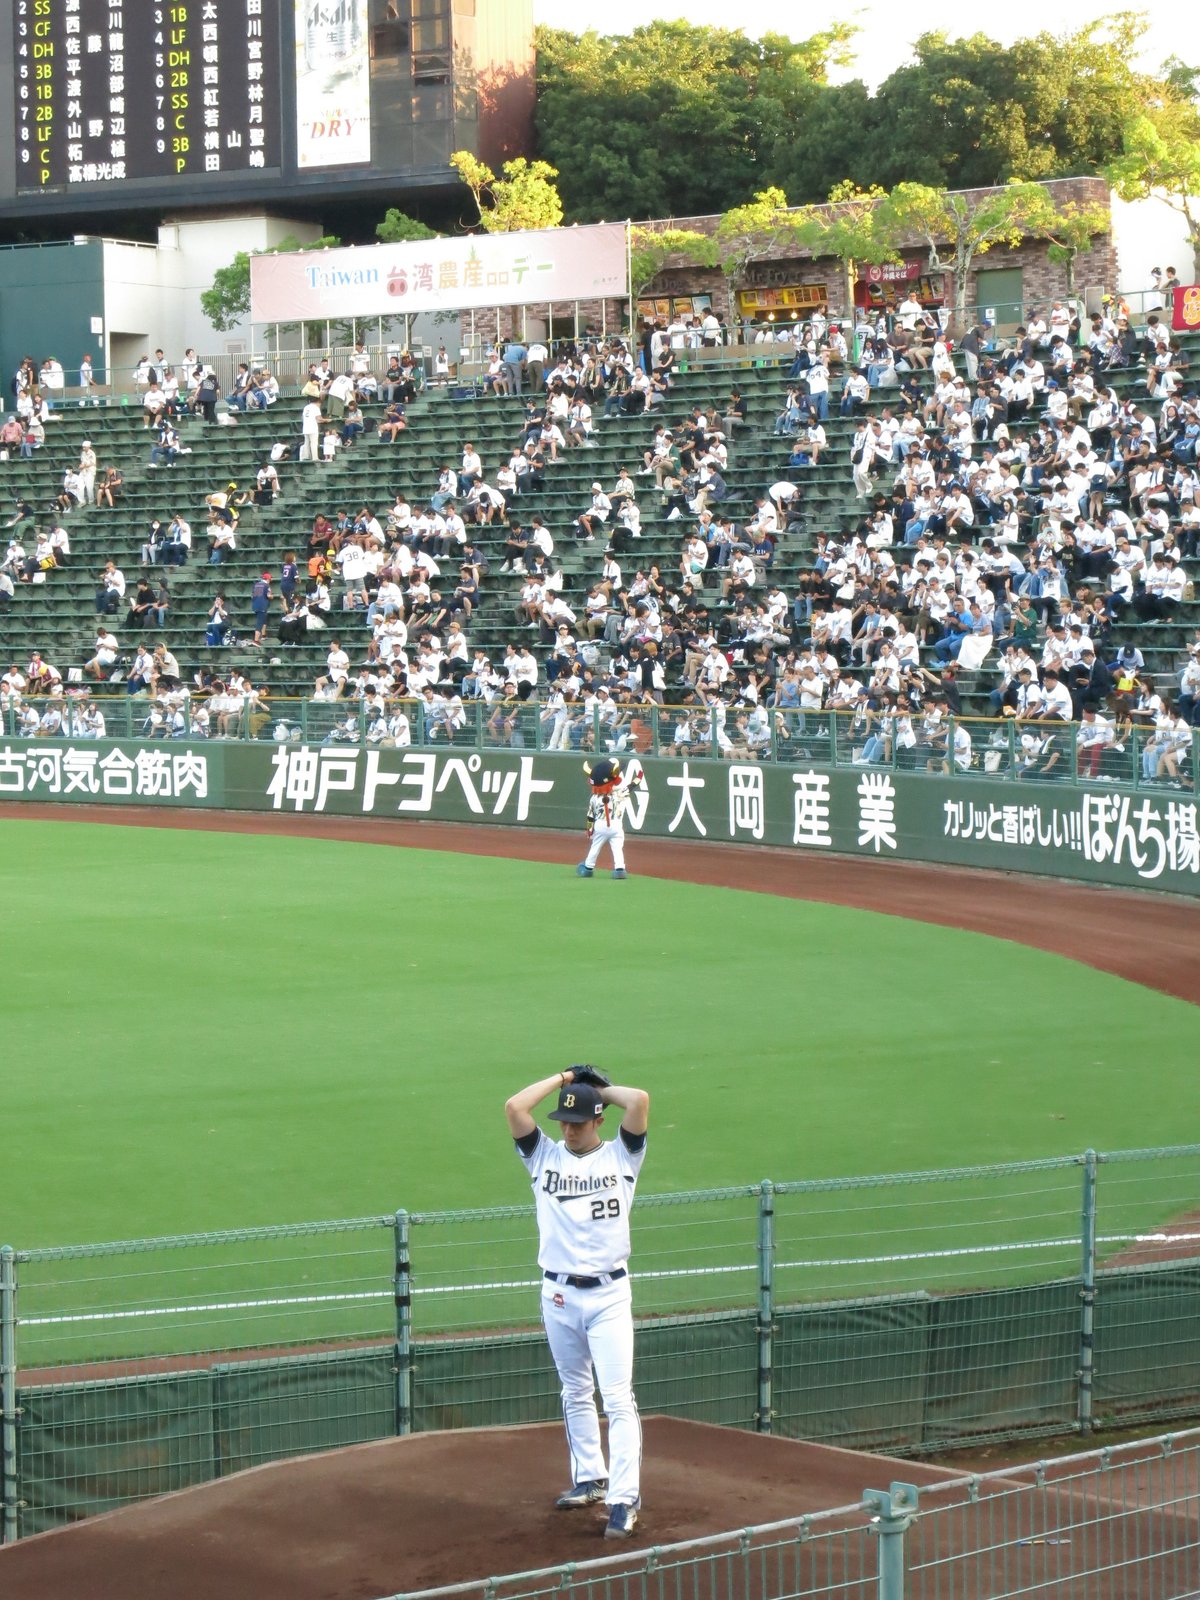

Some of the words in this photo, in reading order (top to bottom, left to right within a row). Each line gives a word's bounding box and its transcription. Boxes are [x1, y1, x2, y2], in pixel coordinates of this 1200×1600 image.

[19, 1, 27, 14] 2
[34, 0, 51, 16] SS
[154, 9, 163, 23] 3
[170, 8, 187, 22] 1B
[202, 0, 262, 20] 太田
[19, 22, 28, 36] 3
[34, 21, 51, 36] CF
[66, 12, 123, 33] 西川
[154, 31, 163, 45] 4
[171, 29, 186, 44] LF
[202, 19, 262, 41] 西川
[19, 43, 28, 57] 4
[33, 43, 54, 58] DH
[155, 53, 164, 67] 5
[169, 51, 190, 66] DH
[20, 64, 28, 78] 5
[35, 64, 52, 79] 3B
[66, 55, 124, 76] 平沼
[155, 74, 164, 88] 6
[171, 72, 188, 87] 2B
[202, 62, 263, 84] 西野
[20, 86, 28, 99] 6
[36, 85, 53, 99] 1B
[155, 96, 164, 110] 7
[171, 94, 189, 109] SS
[203, 84, 264, 106] 紅林
[20, 107, 28, 120] 7
[36, 106, 53, 121] 2B
[156, 117, 165, 131] 8
[175, 115, 185, 129] C
[203, 106, 263, 127] 若月
[21, 127, 30, 140] 8
[38, 127, 52, 141] LF
[67, 118, 126, 139] 山野辺
[21, 149, 30, 162] 9
[40, 149, 50, 163] C
[156, 139, 165, 153] 9
[172, 137, 189, 152] 3B
[41, 170, 50, 183] P
[176, 159, 186, 173] P
[307, 264, 379, 289] Taiwan
[345, 551, 360, 562] 38
[0, 746, 207, 799] 古河気合筋肉
[265, 744, 555, 822] 神戸トヨペット
[666, 760, 898, 854] 大岡産業
[563, 1093, 576, 1108] B
[590, 1198, 620, 1221] 29
